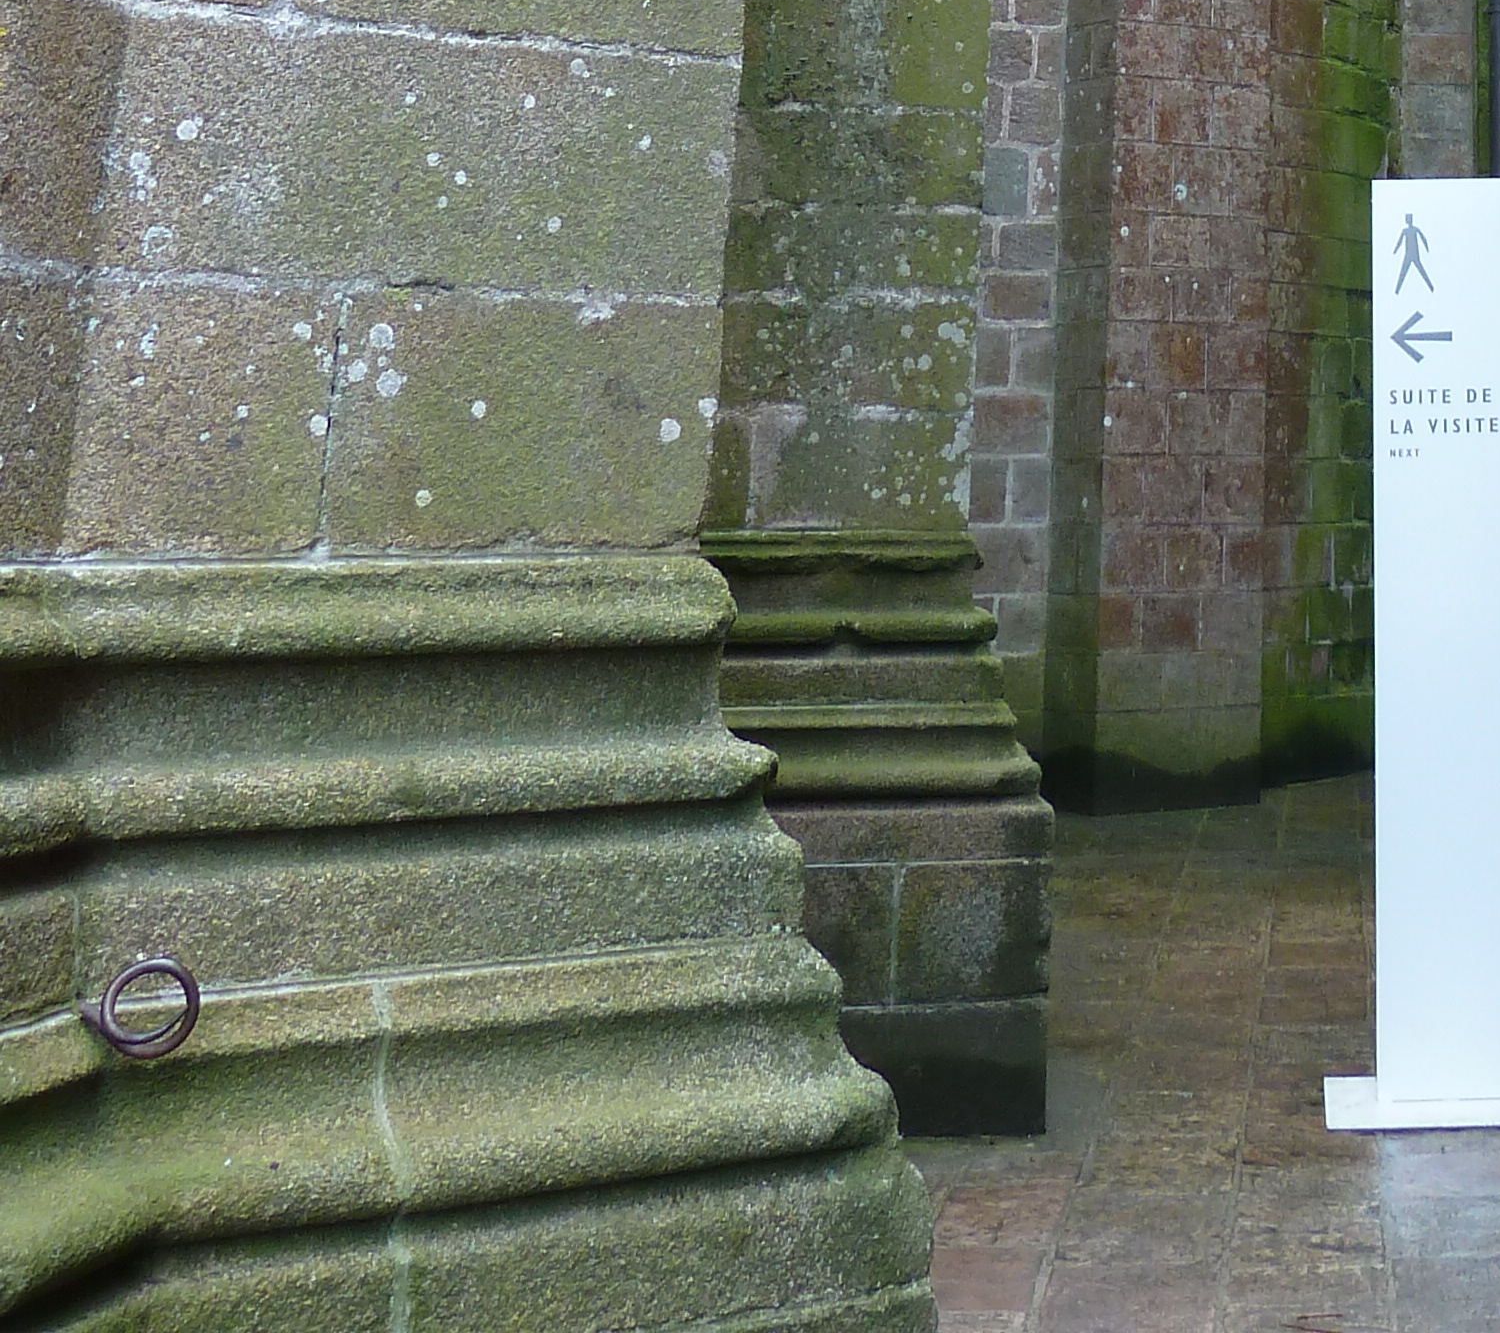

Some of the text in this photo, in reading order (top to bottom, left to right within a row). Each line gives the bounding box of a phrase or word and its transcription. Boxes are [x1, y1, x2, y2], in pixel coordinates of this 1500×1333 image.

[1389, 388, 1492, 405] SUITE DE
[1390, 417, 1499, 435] LA VISITE
[1389, 448, 1420, 458] NEXT
